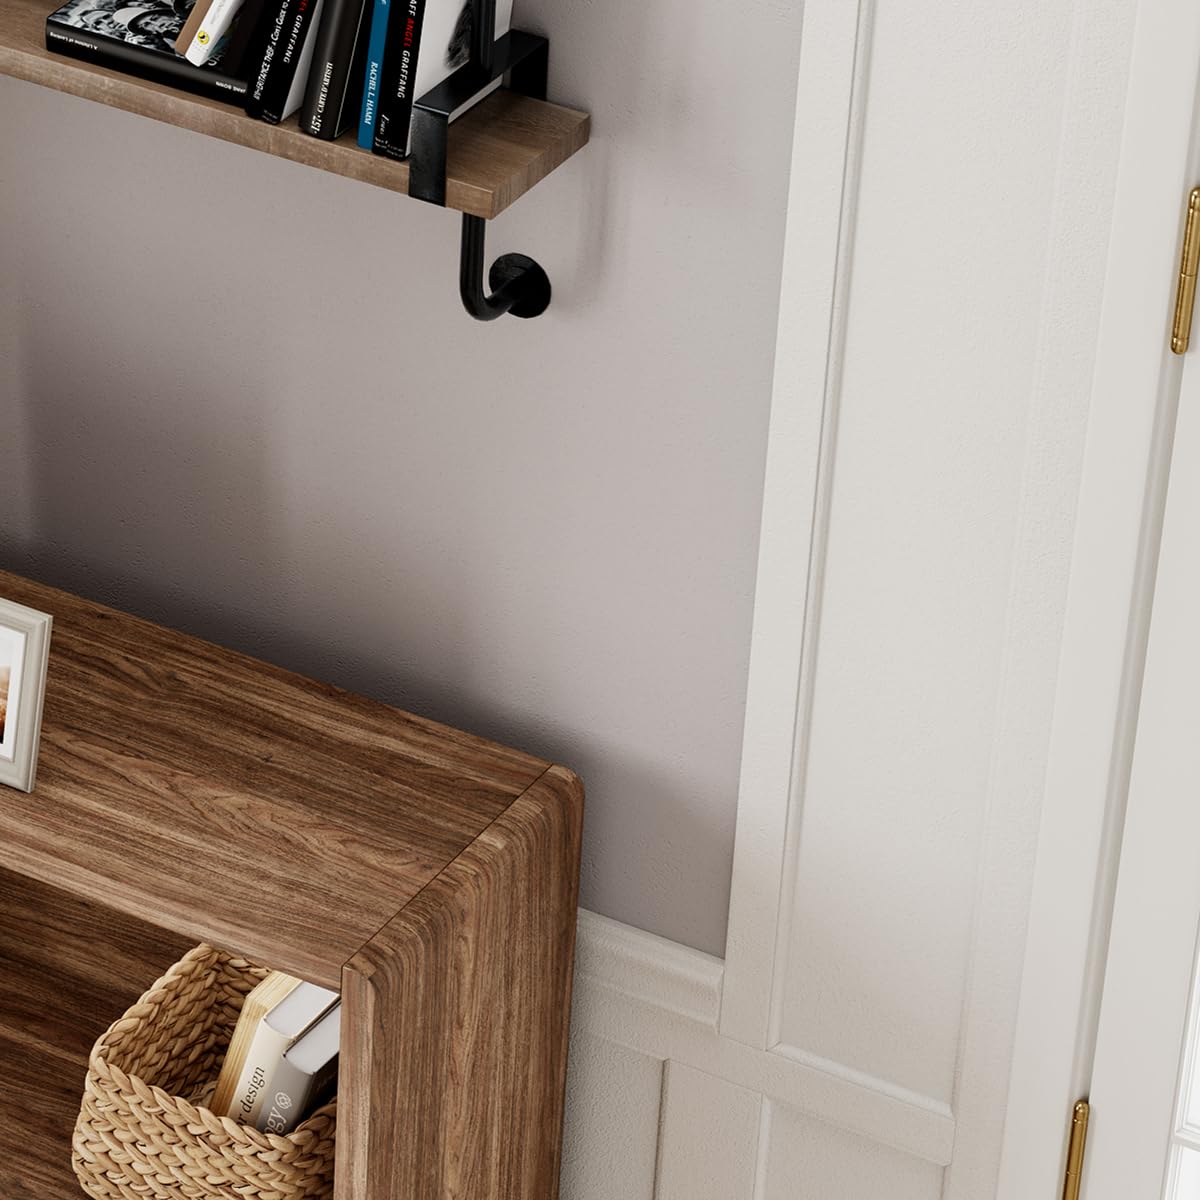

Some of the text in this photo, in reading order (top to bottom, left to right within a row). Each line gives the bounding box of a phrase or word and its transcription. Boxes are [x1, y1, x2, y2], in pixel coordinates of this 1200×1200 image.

[283, 14, 303, 64] GRAFFANG
[368, 61, 378, 93] RACHEL
[397, 50, 411, 99] GRAFFANG
[317, 90, 328, 113] CARTE
[364, 100, 375, 125] HAMM
[240, 1066, 266, 1113] design
